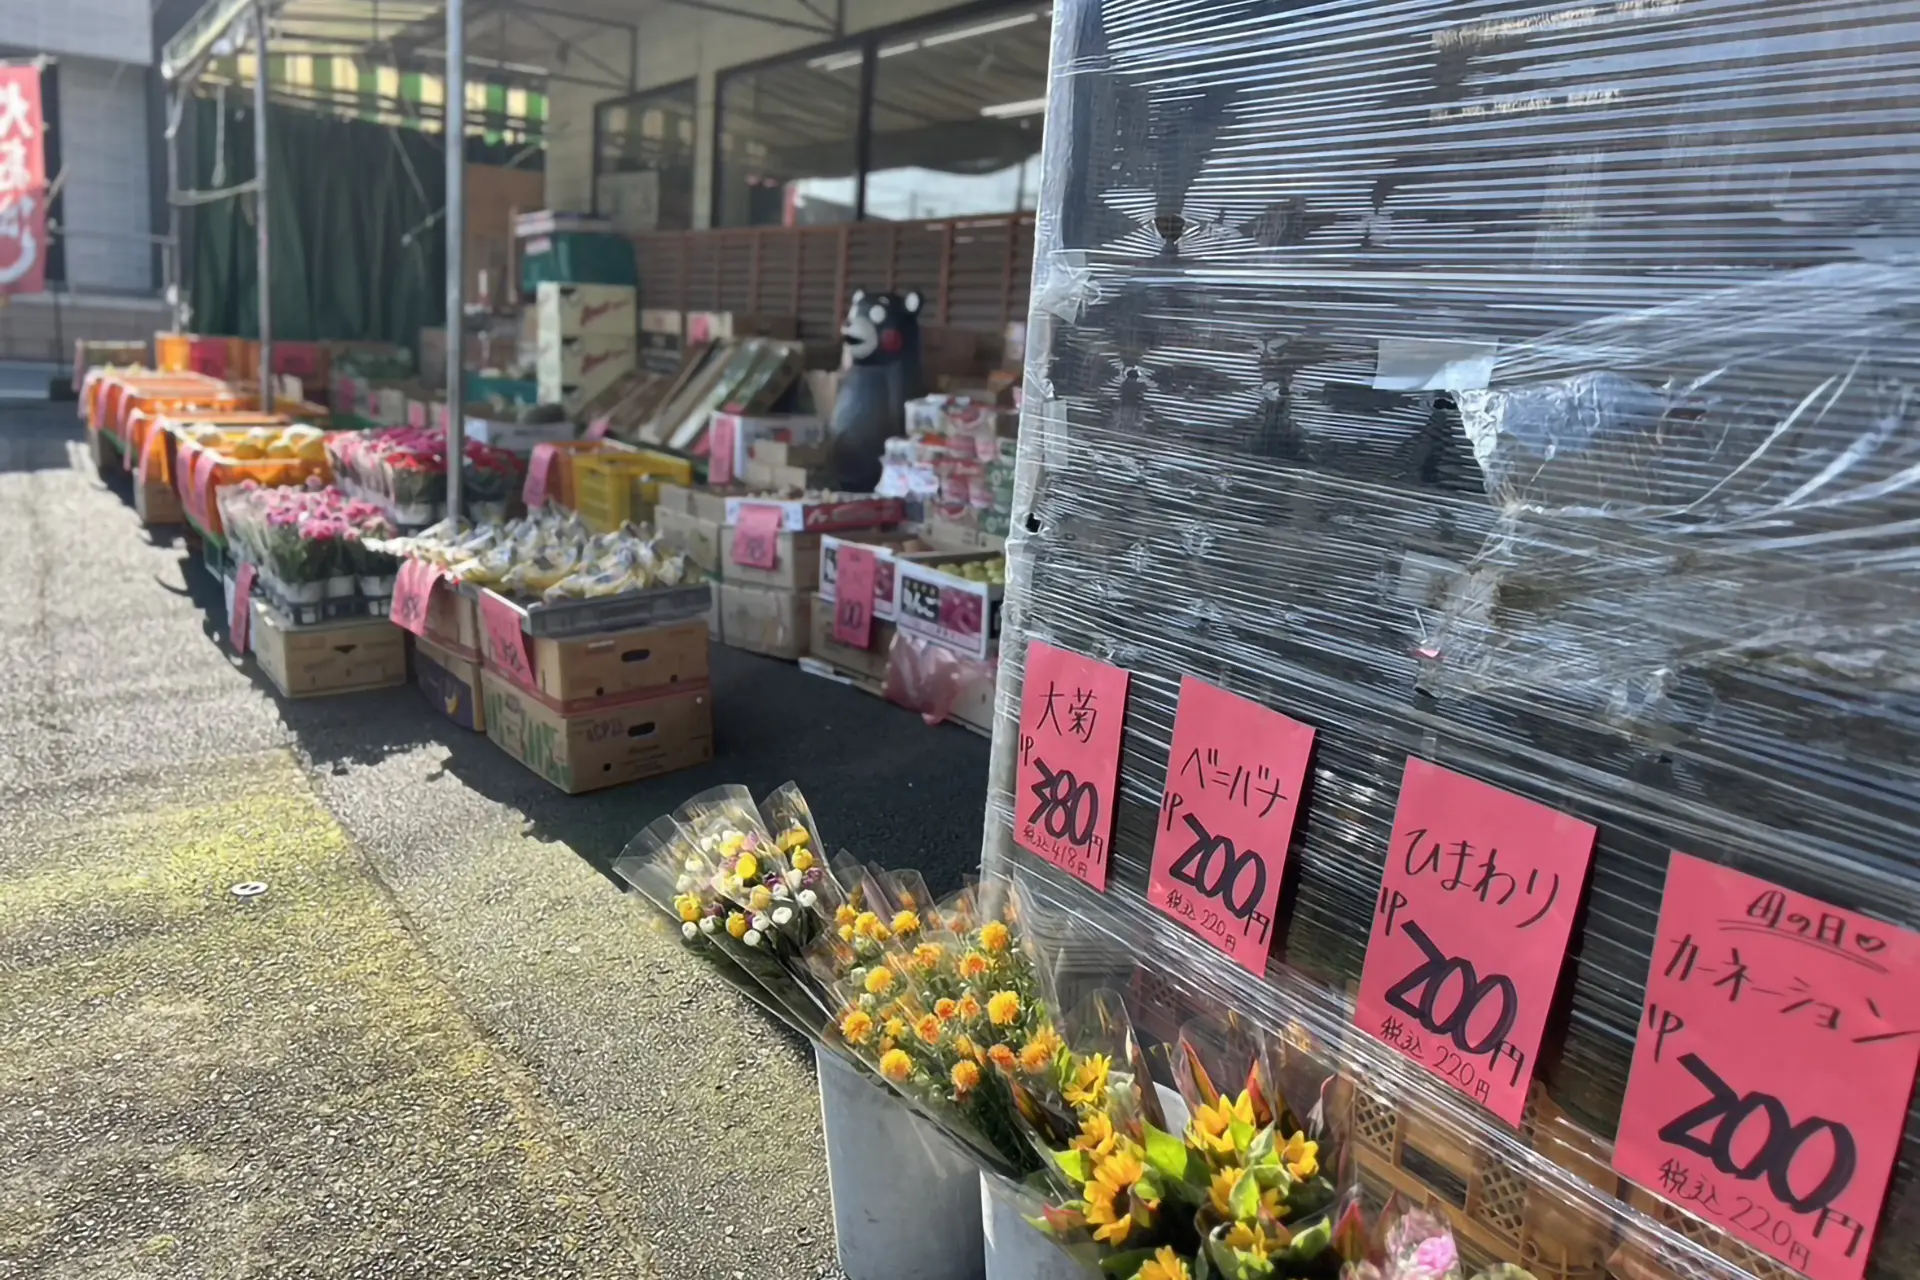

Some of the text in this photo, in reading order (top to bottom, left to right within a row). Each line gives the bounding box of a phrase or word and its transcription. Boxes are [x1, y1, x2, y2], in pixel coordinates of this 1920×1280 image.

[1036, 681, 1098, 743] 大菊
[1180, 747, 1289, 818] ベニバナ
[1403, 828, 1559, 929] ひまわり
[1664, 934, 1920, 1044] カーネーション
